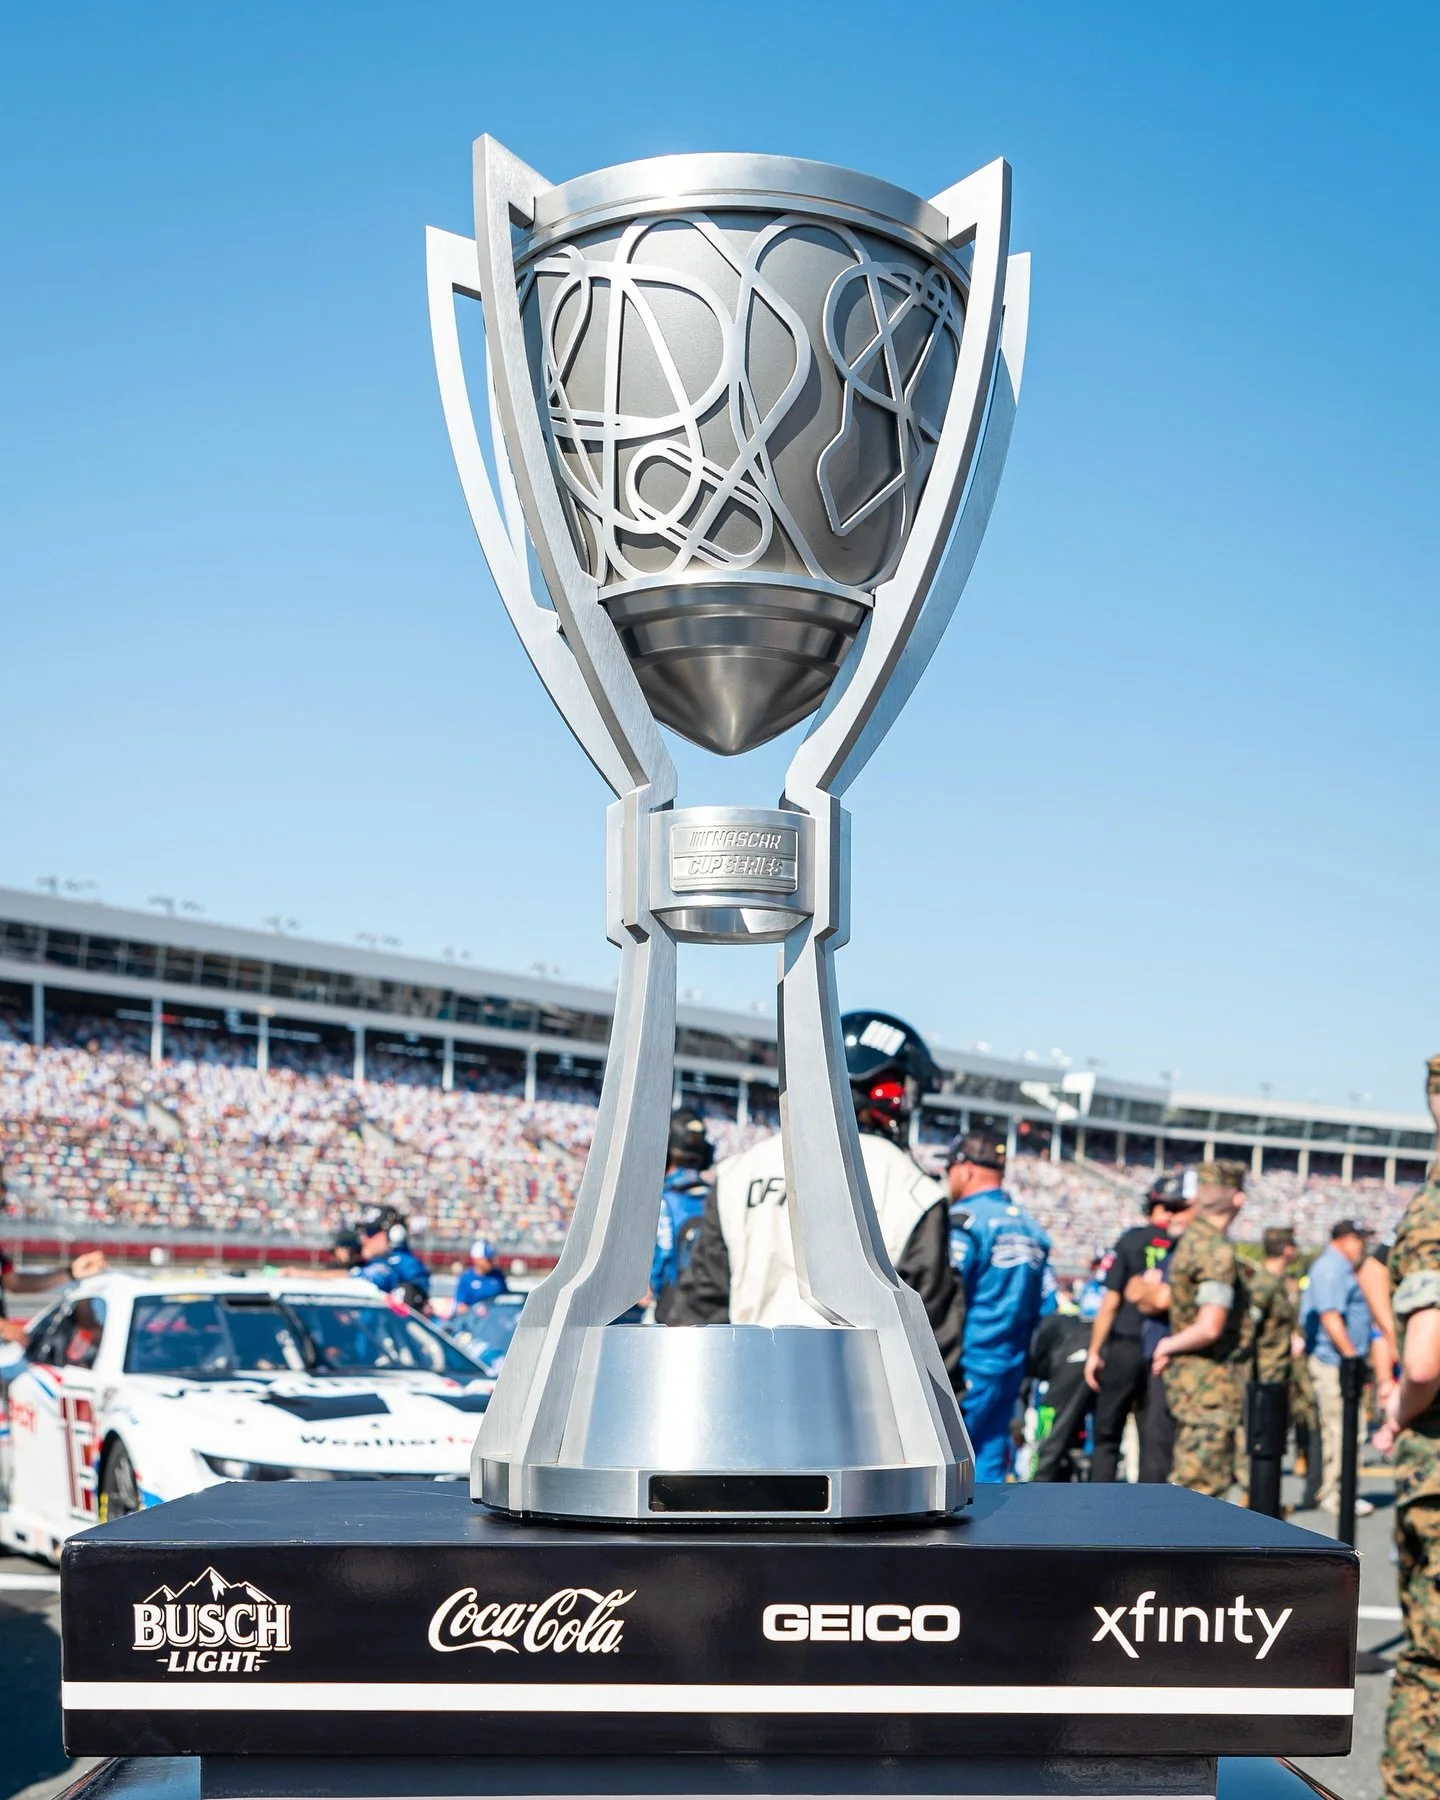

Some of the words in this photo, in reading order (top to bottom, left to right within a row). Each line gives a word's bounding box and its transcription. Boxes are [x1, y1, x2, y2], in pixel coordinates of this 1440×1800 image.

[705, 830, 782, 850] NASCAR
[688, 856, 723, 875] CUP
[723, 857, 784, 877] SERIES
[132, 1603, 292, 1651] BUSCH
[427, 1586, 638, 1654] Coca-Cola
[762, 1603, 961, 1642] GEICO
[1091, 1590, 1294, 1660] xfinity
[167, 1650, 261, 1673] LIGHT
